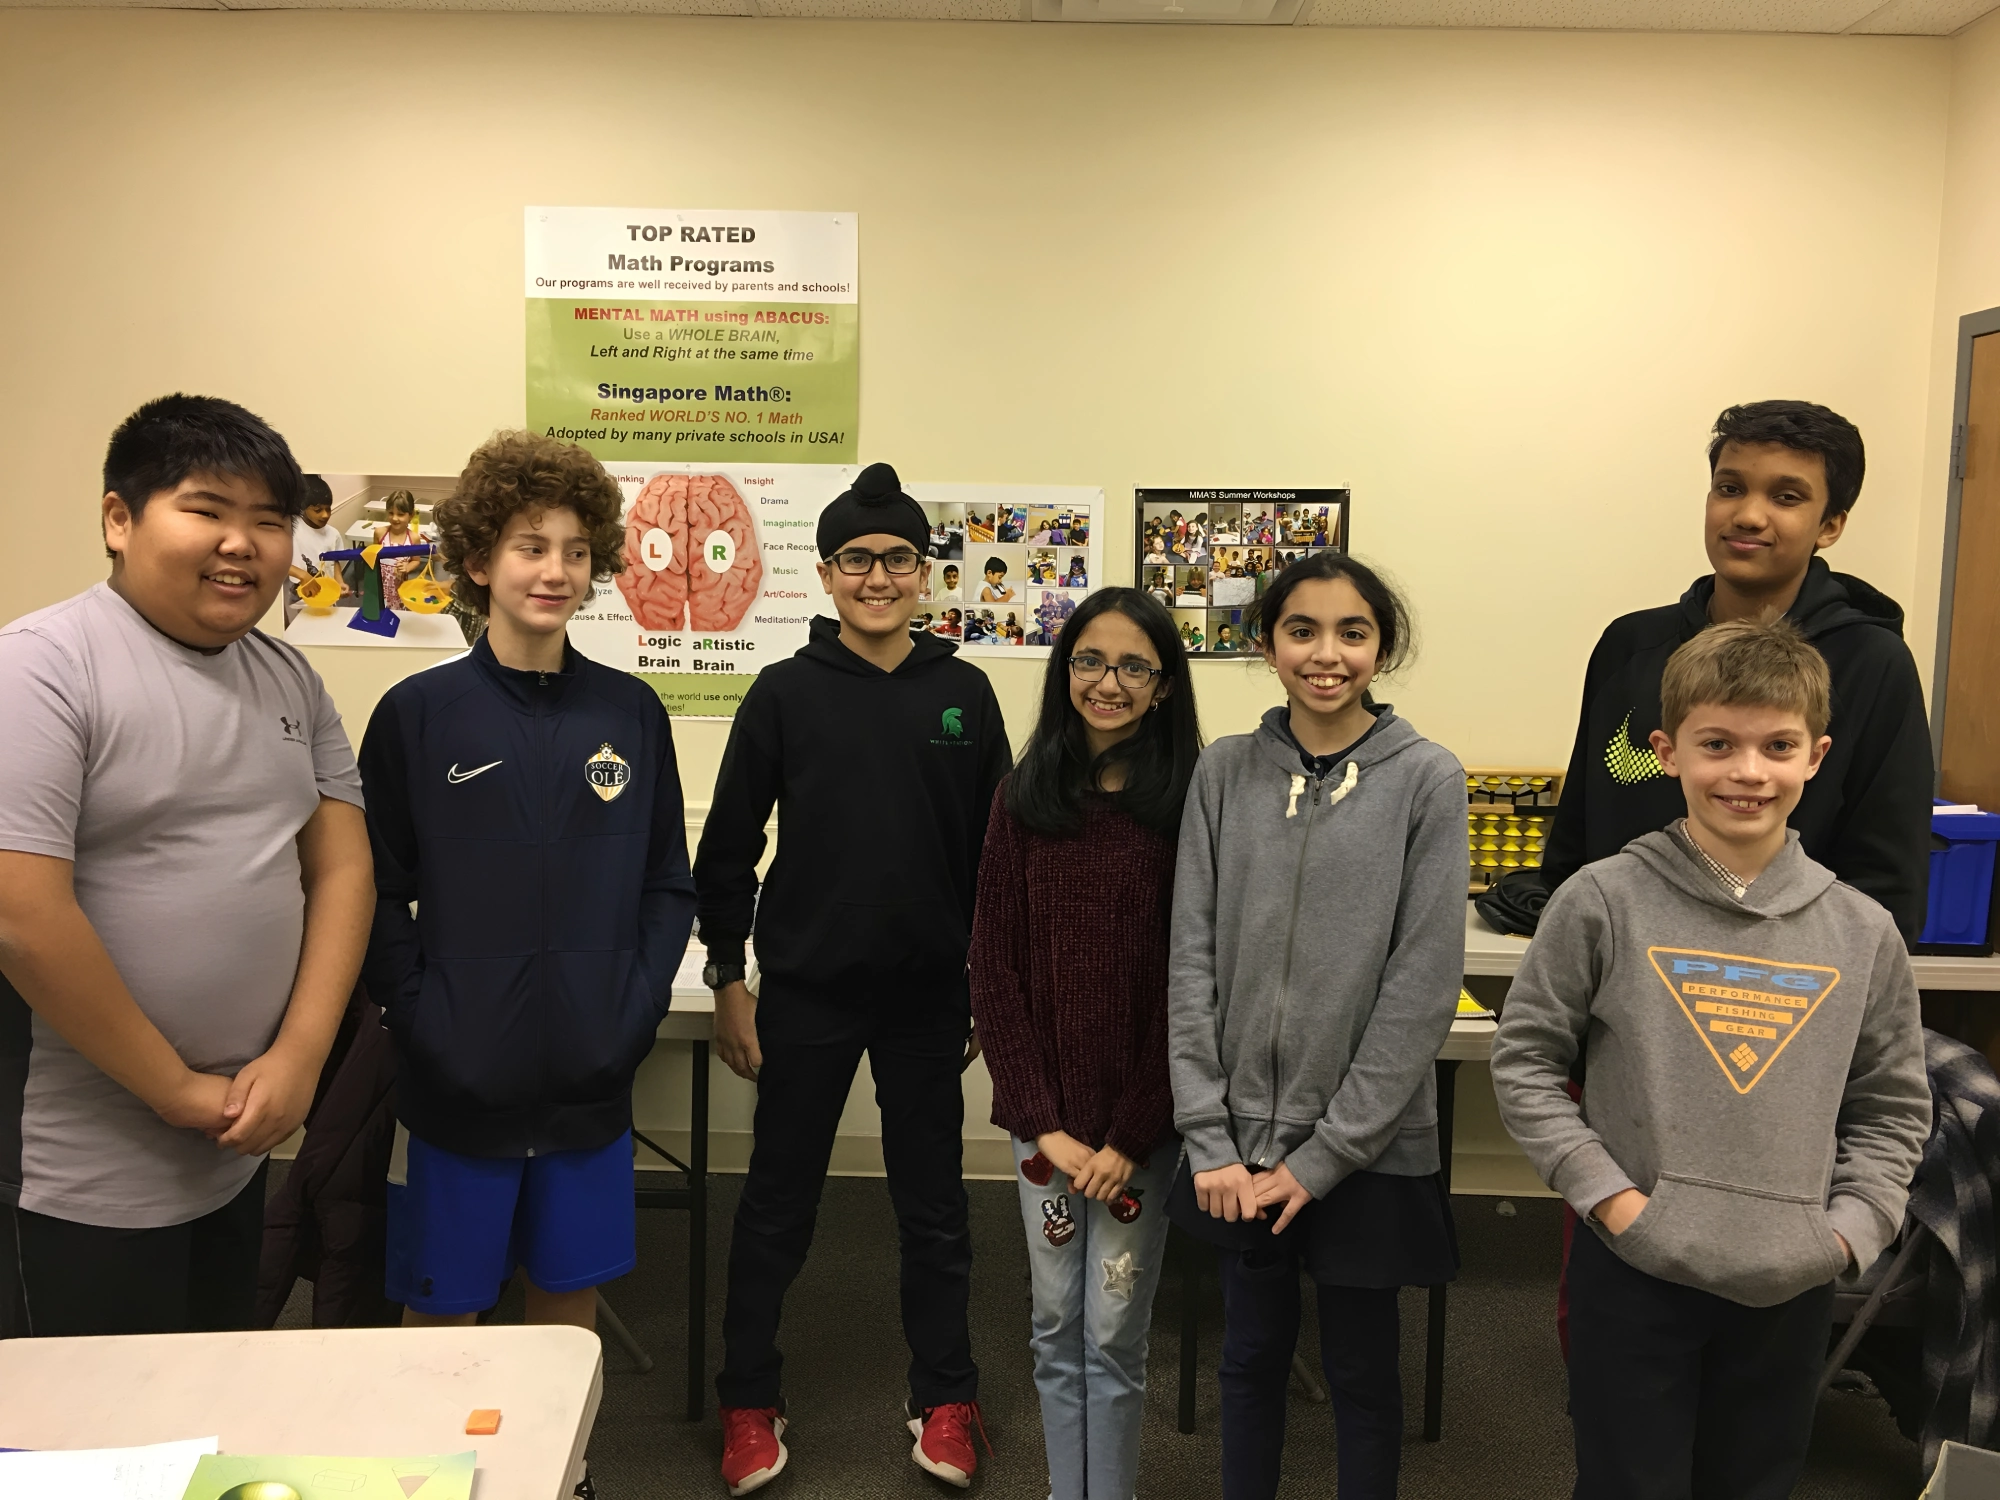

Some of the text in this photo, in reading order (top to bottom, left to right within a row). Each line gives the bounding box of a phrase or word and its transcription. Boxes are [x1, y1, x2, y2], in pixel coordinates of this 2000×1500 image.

[627, 225, 756, 243] TOP RATED
[608, 254, 775, 276] Math Programs
[536, 277, 850, 293] Our programs are well received by parents and schools!
[574, 308, 830, 325] MENTAL MATH using ABACUS:
[623, 328, 780, 345] Use a WHOLE BRAIN,
[590, 345, 814, 361] Left and Right at the same time
[597, 383, 792, 403] Singapore Math®:
[590, 409, 646, 422] Ranked
[725, 411, 751, 423] NO.
[756, 412, 763, 423] 1
[768, 412, 803, 424] Math
[546, 426, 845, 445] Adopted by many private schools in USA!
[617, 474, 645, 484] inking
[744, 476, 774, 487] Insight
[760, 497, 789, 505] Drama
[1189, 491, 1296, 500] MMA'S Summer Workshops
[763, 519, 814, 529] Imagination
[649, 543, 662, 559] L
[712, 545, 727, 561] R
[763, 542, 784, 551] Face
[772, 566, 799, 575] Music
[595, 587, 613, 597] lyze
[763, 590, 808, 599] Art/Colors
[598, 613, 605, 621] &
[607, 613, 633, 621] Effect
[638, 635, 682, 650] Logic
[693, 638, 755, 651] aRtistic
[638, 656, 680, 667] Brain
[693, 659, 735, 671] Brain
[660, 692, 675, 701] the
[677, 692, 701, 701] world
[723, 693, 743, 703] only
[591, 762, 624, 771] SOCCER
[1672, 959, 1820, 990] PFG
[1688, 985, 1802, 1007] PERFORMANCE
[1716, 1005, 1776, 1020] FISHING
[1725, 1024, 1766, 1036] GEAR
